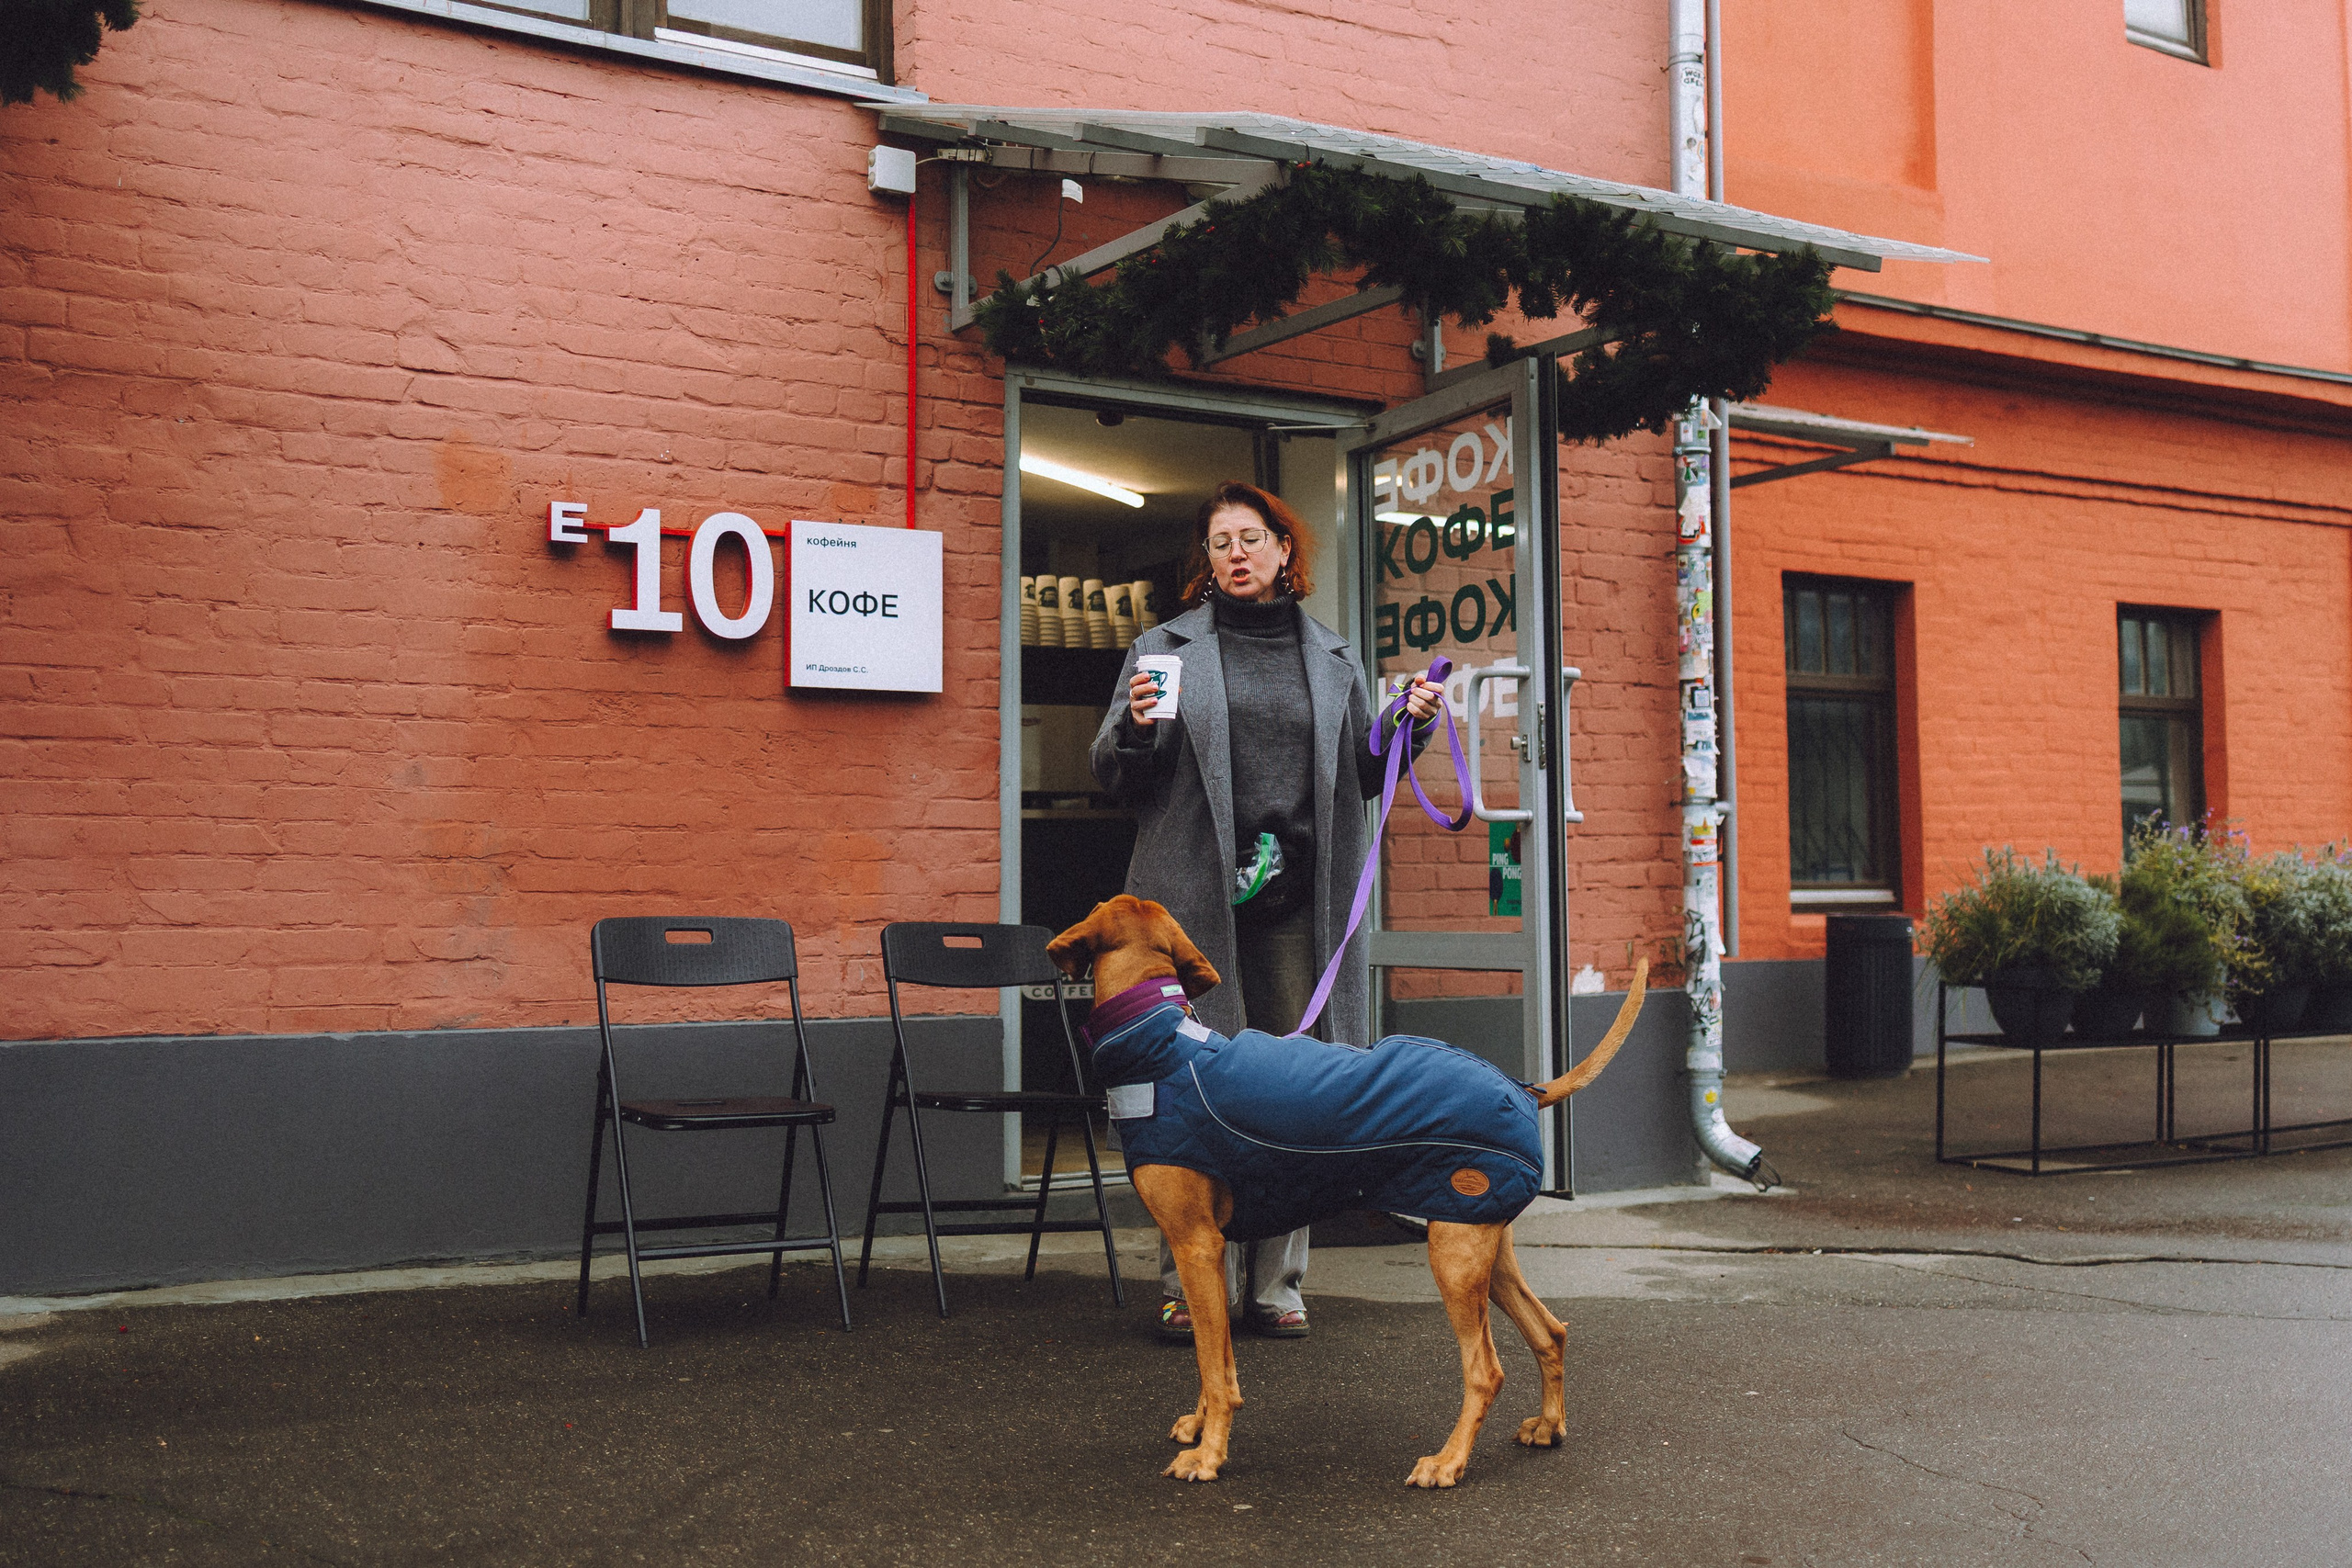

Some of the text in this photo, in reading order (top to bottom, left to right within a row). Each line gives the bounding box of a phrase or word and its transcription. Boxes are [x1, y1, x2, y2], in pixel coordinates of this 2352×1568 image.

[807, 536, 857, 548] кофейня
[1376, 488, 1516, 584] КОФЕ
[606, 508, 775, 640] 10
[808, 589, 899, 618] КОФЕ
[806, 663, 818, 671] ИП
[819, 664, 852, 672] Дроздов
[1492, 853, 1509, 865] PING
[1502, 867, 1521, 880] PONG
